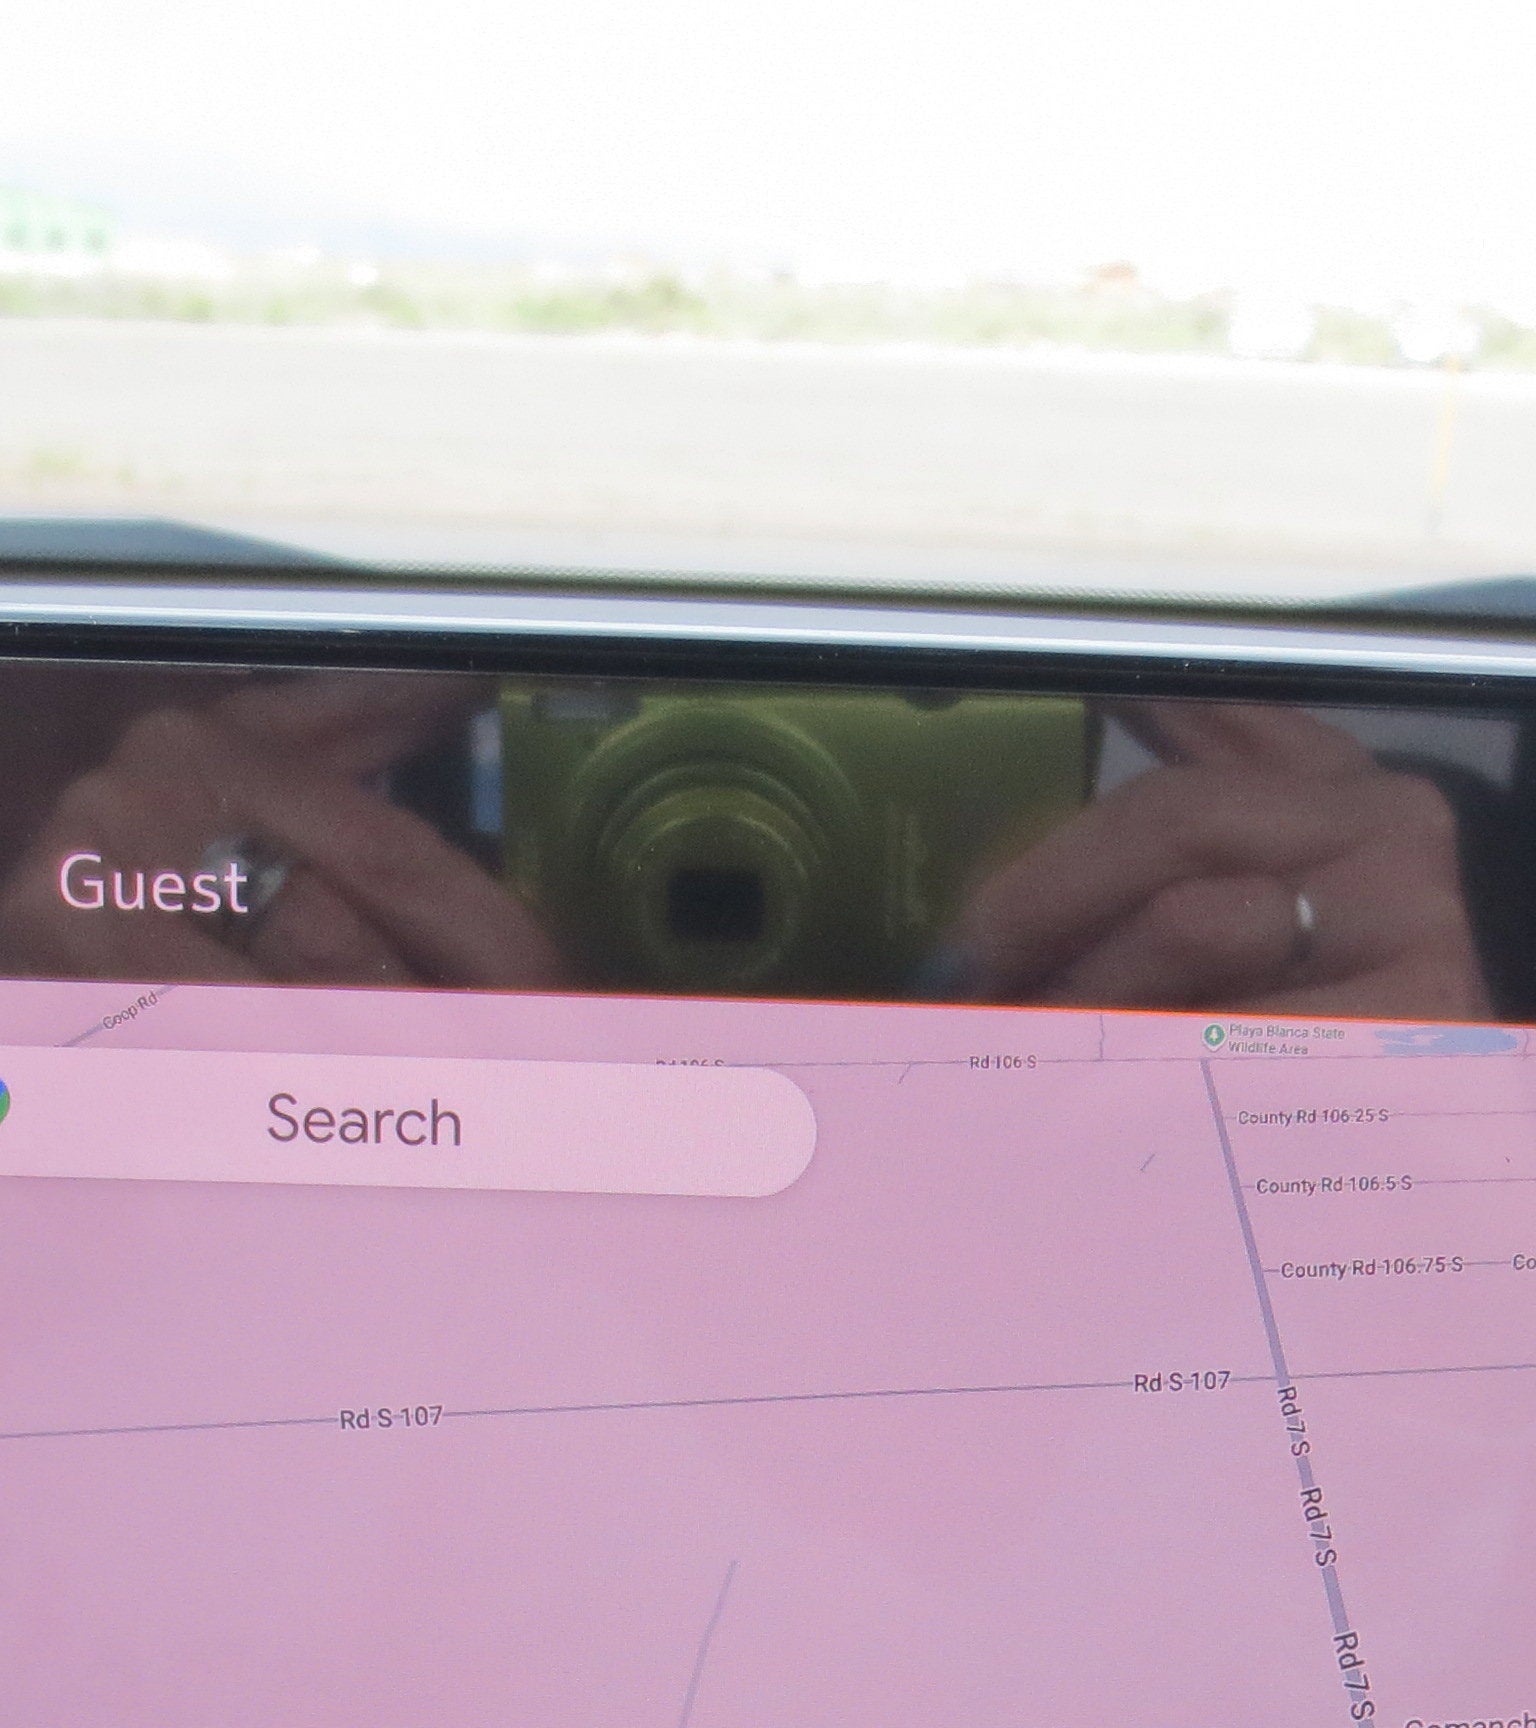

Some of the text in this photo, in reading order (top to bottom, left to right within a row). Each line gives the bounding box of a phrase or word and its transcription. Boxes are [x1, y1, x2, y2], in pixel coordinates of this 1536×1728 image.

[59, 854, 249, 914] Guest
[103, 991, 158, 1029] Coop Rd
[1229, 1023, 1346, 1040] Playa Blanca State
[1228, 1041, 1309, 1055] Wildlife Area
[969, 1054, 1038, 1069] Rd 106 S
[266, 1092, 463, 1148] Search
[1237, 1108, 1389, 1127] County Rd 106.25 S
[1256, 1174, 1413, 1197] County Rd 106.5 S
[1281, 1255, 1464, 1281] County Rd 106.75 S
[1134, 1370, 1232, 1393] Rd S 107
[339, 1405, 444, 1431] Rd S 107
[1277, 1385, 1311, 1457] Rd 7 S
[1300, 1486, 1337, 1567] Rd 7 S
[1333, 1631, 1376, 1721] Rd 7 S
